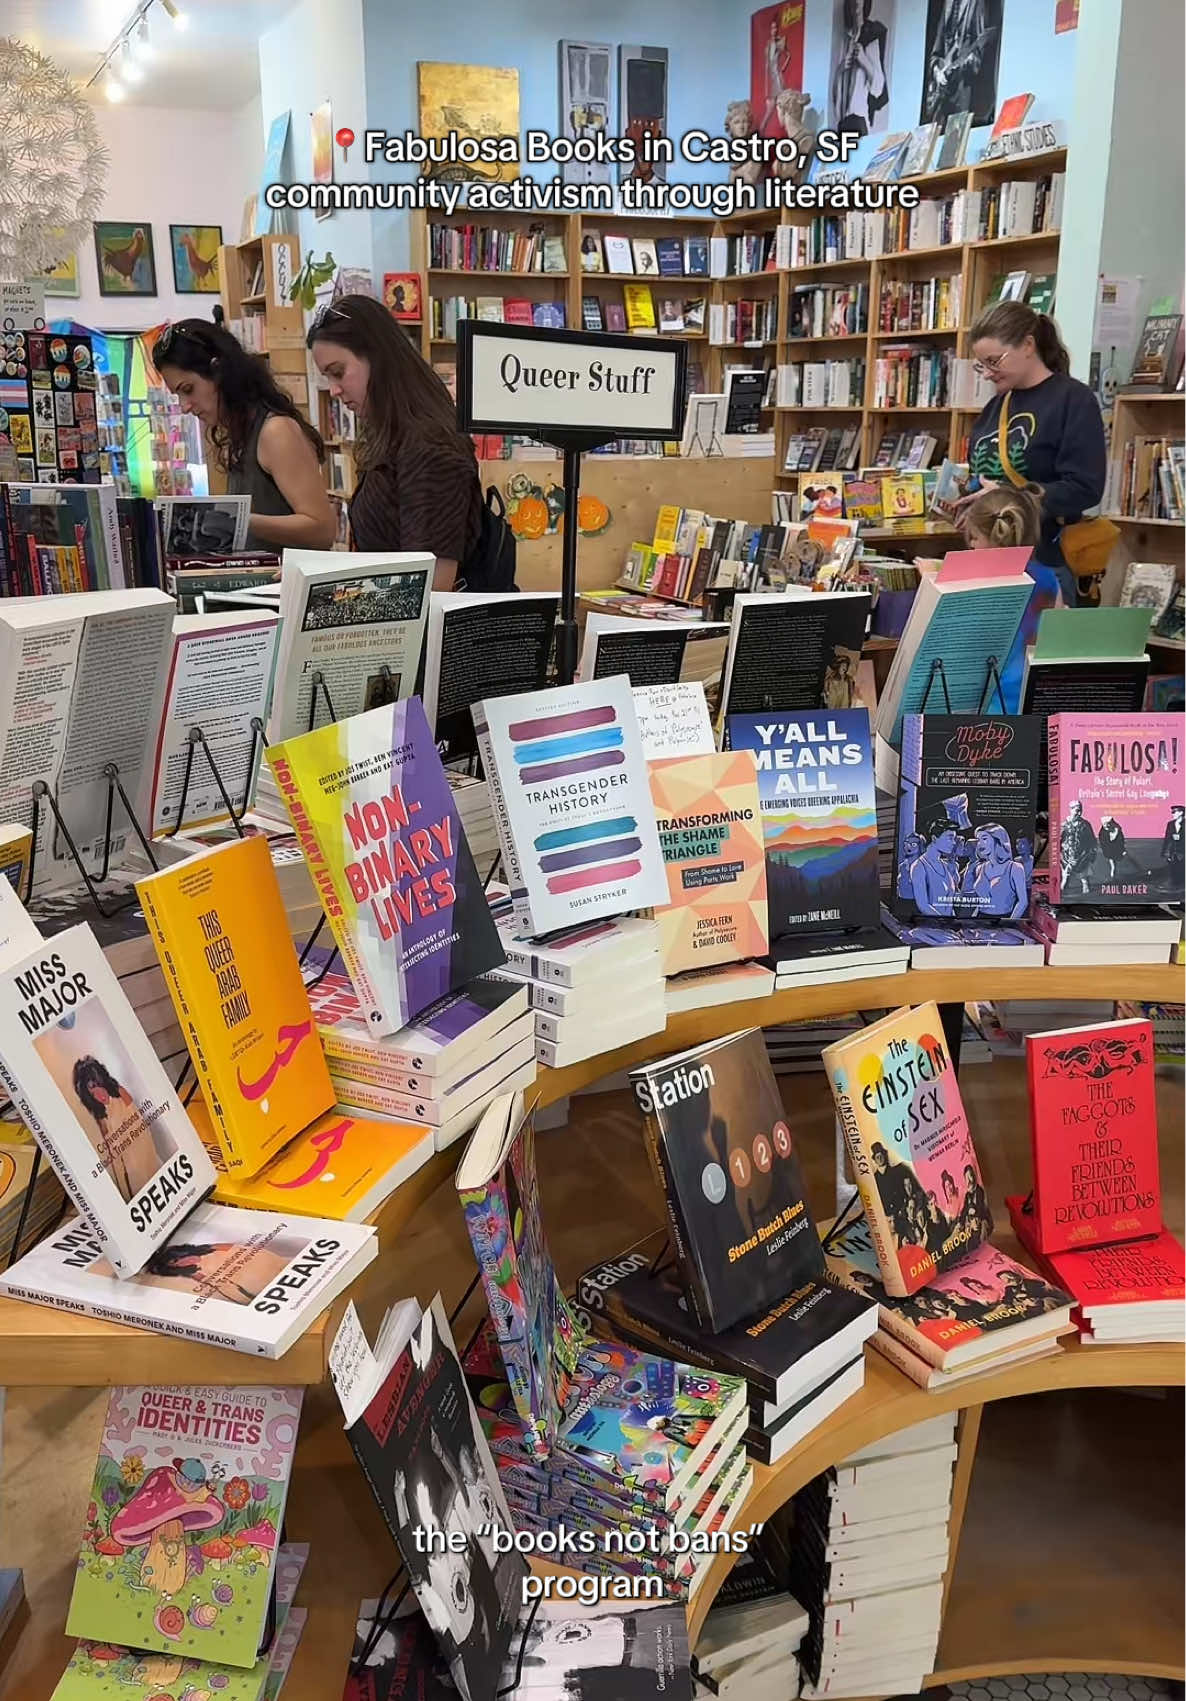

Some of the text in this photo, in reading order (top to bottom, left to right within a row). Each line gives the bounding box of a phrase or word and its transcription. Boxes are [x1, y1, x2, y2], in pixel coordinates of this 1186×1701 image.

[500, 353, 656, 395] Queer Stuff
[386, 743, 415, 758] VINCENT
[754, 720, 848, 745] Y'ALL
[956, 720, 1011, 744] Moby
[755, 743, 863, 771] MEANS
[956, 740, 1003, 767] Dyke
[1049, 724, 1060, 787] FABULOSA!
[1070, 737, 1178, 775] FABULOSA!
[526, 773, 629, 804] TRANSGENDER
[764, 798, 790, 811] EMERGING
[790, 797, 807, 809] VOICES
[831, 793, 860, 805] APPALACHIA
[774, 771, 838, 795] ALL
[272, 758, 326, 864] NON-BINARY
[344, 784, 422, 851] NON-
[484, 740, 522, 882] TRANSGENDER HISTORY
[549, 792, 608, 815] HISTORY
[656, 808, 754, 833] TRANSFORMING
[659, 827, 726, 847] THE SHAME
[662, 842, 719, 862] TRIANGLE
[344, 815, 454, 904] BINARY
[315, 868, 344, 918] LIVES
[371, 868, 457, 942] LIVES
[569, 888, 628, 909] SUSAN STRYKER
[1101, 882, 1148, 894] PAUL BAKER
[198, 909, 222, 941] THIS
[692, 932, 737, 949] & DAVID COOLEY
[697, 915, 733, 930] JESSICA FERN
[204, 936, 235, 974] QUEER
[14, 953, 67, 1000] MISS
[216, 971, 242, 1000] ARAB
[18, 971, 92, 1035] MAJOR
[145, 892, 234, 1152] THIS QUEER ARAB FAMILY
[221, 994, 252, 1030] FAMILY
[888, 1037, 909, 1062] The
[635, 1061, 716, 1114] Station
[862, 1043, 948, 1115] EINSTEIN
[1087, 1081, 1113, 1102] THE
[96, 1097, 153, 1154] Conversations with
[894, 1086, 945, 1143] of SEX
[1061, 1096, 1137, 1125] FAGGOTS
[1095, 1118, 1107, 1138] &
[96, 1100, 171, 1174] Black Trans Revolutionary
[840, 1095, 861, 1146] EINSTEIN
[856, 1153, 870, 1177] SEX
[1078, 1138, 1122, 1163] THEIR
[18, 1098, 41, 1133] TOSHIO
[38, 1129, 67, 1178] MERONEK
[62, 1175, 78, 1197] AND
[74, 1191, 91, 1215] MISS
[87, 1211, 109, 1243] MAJOR
[735, 1130, 788, 1181] 1 2 3
[1070, 1156, 1137, 1183] FRIENDS
[130, 1154, 195, 1234] SPEAKS
[1071, 1175, 1137, 1202] BETWEEN
[1054, 1191, 1156, 1225] REVOLUTIONS
[728, 1199, 805, 1264] Stone Butch Blues
[766, 1216, 810, 1257] Leslie Feinberg
[863, 1194, 889, 1266] DANIEL BROOK
[193, 1231, 264, 1294] Conversations with
[218, 1263, 242, 1288] Trans
[239, 1221, 289, 1269] Revolutionary
[910, 1228, 973, 1278] DANIEL BROOK
[254, 1238, 341, 1315] SPEAKS
[582, 1252, 650, 1310] Station
[7, 1286, 237, 1347] MISS MAJOR SPEAKS TOSHIO MERONEK AND MISS MAJOR
[746, 1312, 776, 1338] Stone
[773, 1294, 801, 1321] Butch
[788, 1286, 833, 1323] Leslie Feinberg
[938, 1303, 1027, 1341] DANIEL BROOK
[141, 1391, 265, 1423] QUEER & TRANS
[194, 1388, 267, 1408] EASY GUIDE TO
[136, 1406, 262, 1445] IDENTITIES
